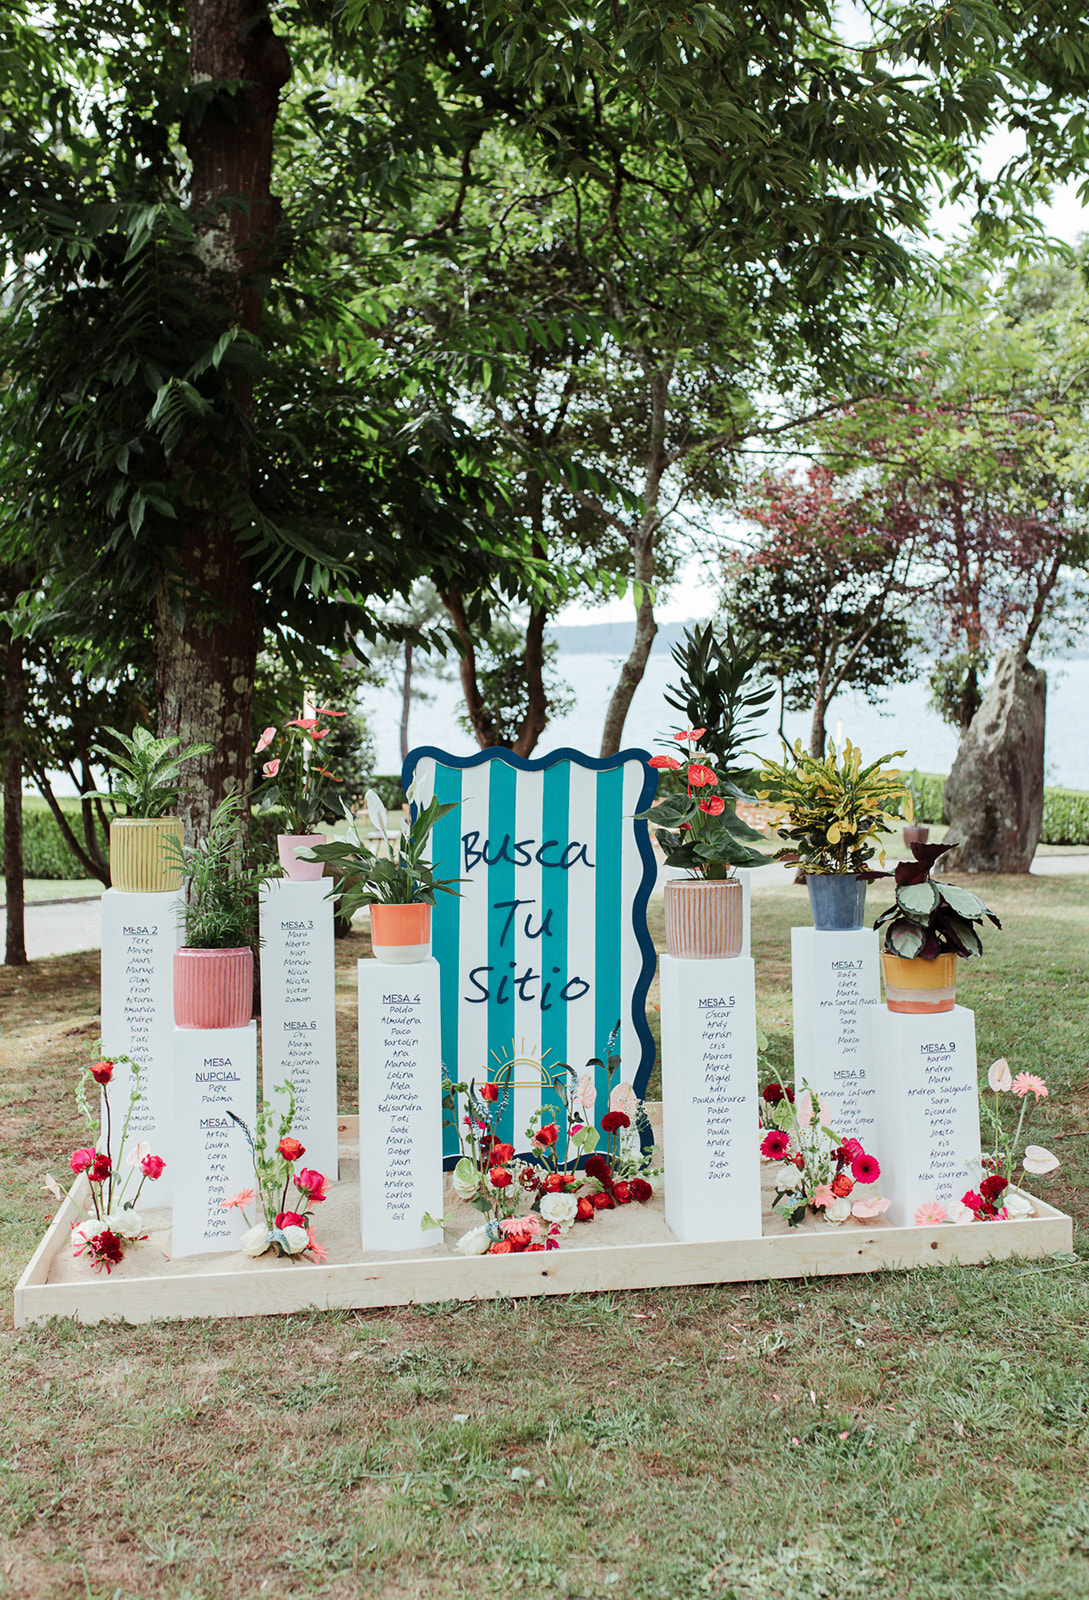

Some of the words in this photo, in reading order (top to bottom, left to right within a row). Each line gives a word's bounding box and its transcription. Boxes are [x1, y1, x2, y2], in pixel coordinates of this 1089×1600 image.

[461, 830, 596, 874] Busca
[308, 920, 314, 928] 3
[493, 899, 552, 947] Tu
[123, 926, 149, 934] MESA
[152, 926, 158, 934] 2
[464, 962, 590, 1012] Sitio
[383, 994, 410, 1002] MESA
[414, 994, 420, 1002] 4
[699, 998, 726, 1006] MESA
[729, 996, 736, 1006] 5
[381, 1016, 421, 1025] Almudena
[708, 1020, 727, 1030] Andy
[920, 1043, 946, 1052] MESA
[949, 1042, 956, 1050] 9
[703, 1052, 732, 1060] Marcos
[204, 1058, 232, 1066] MESA
[384, 1060, 416, 1068] Manolo
[860, 1069, 866, 1077] 8
[925, 1065, 952, 1073] Andrea
[196, 1072, 240, 1080] NUPCIAL
[705, 1074, 731, 1084] Miguel
[209, 1084, 226, 1093] Pepe
[908, 1088, 936, 1096] Andrea
[940, 1084, 972, 1096] Salgado
[692, 1096, 715, 1104] Paula
[707, 1106, 729, 1114] Pablo
[924, 1106, 957, 1116] Ricardo
[200, 1118, 228, 1127] MESA
[208, 1218, 226, 1228] Pepa
[204, 1230, 231, 1238] Alonso
